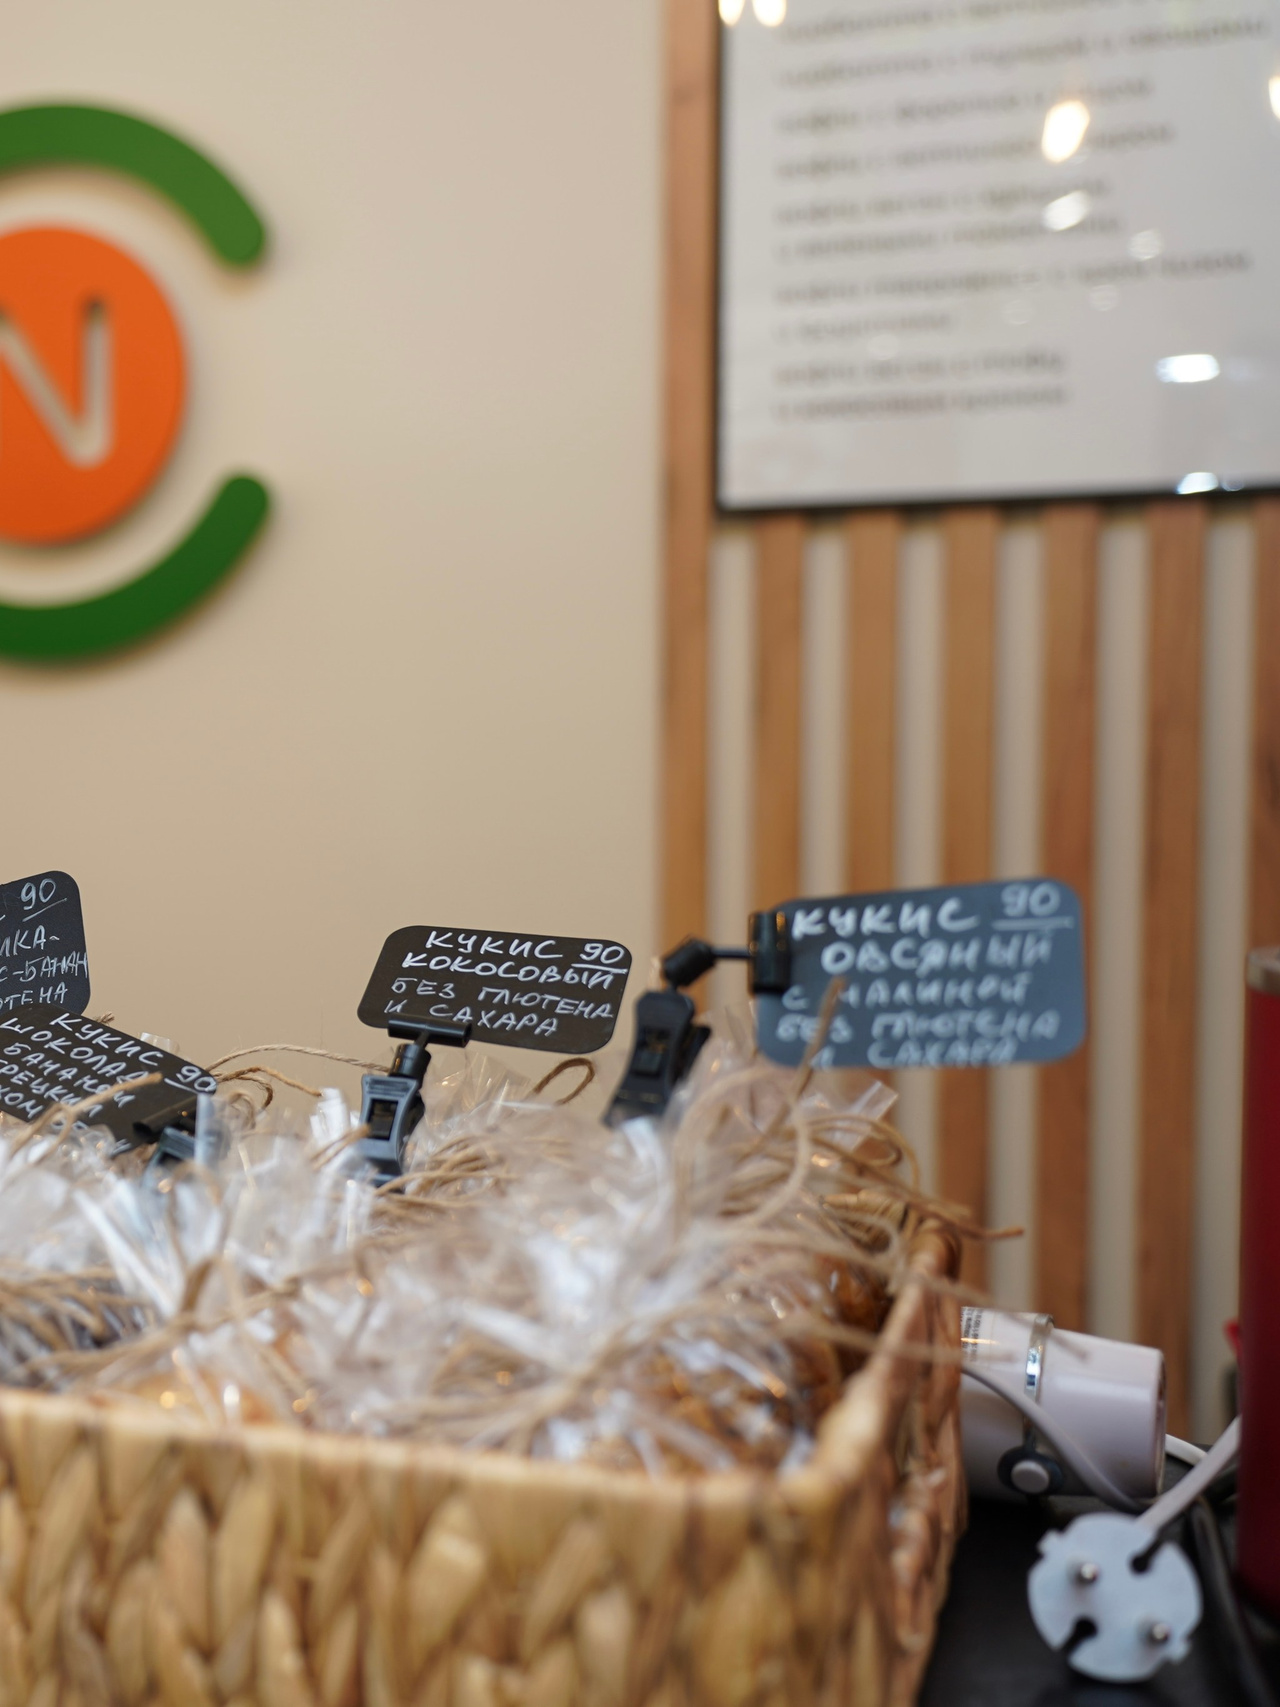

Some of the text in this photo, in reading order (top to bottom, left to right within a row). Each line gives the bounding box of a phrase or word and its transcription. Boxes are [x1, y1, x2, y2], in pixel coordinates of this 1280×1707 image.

[21, 878, 57, 910] 90
[791, 882, 1061, 941] КУКИС 90
[425, 931, 625, 964] КУКИС 90
[391, 977, 614, 1019] БЕЗ ГЛЮТЕНА
[781, 984, 809, 1011] С
[384, 999, 558, 1037] И САХАРА
[49, 1012, 218, 1094] КУКИС 90
